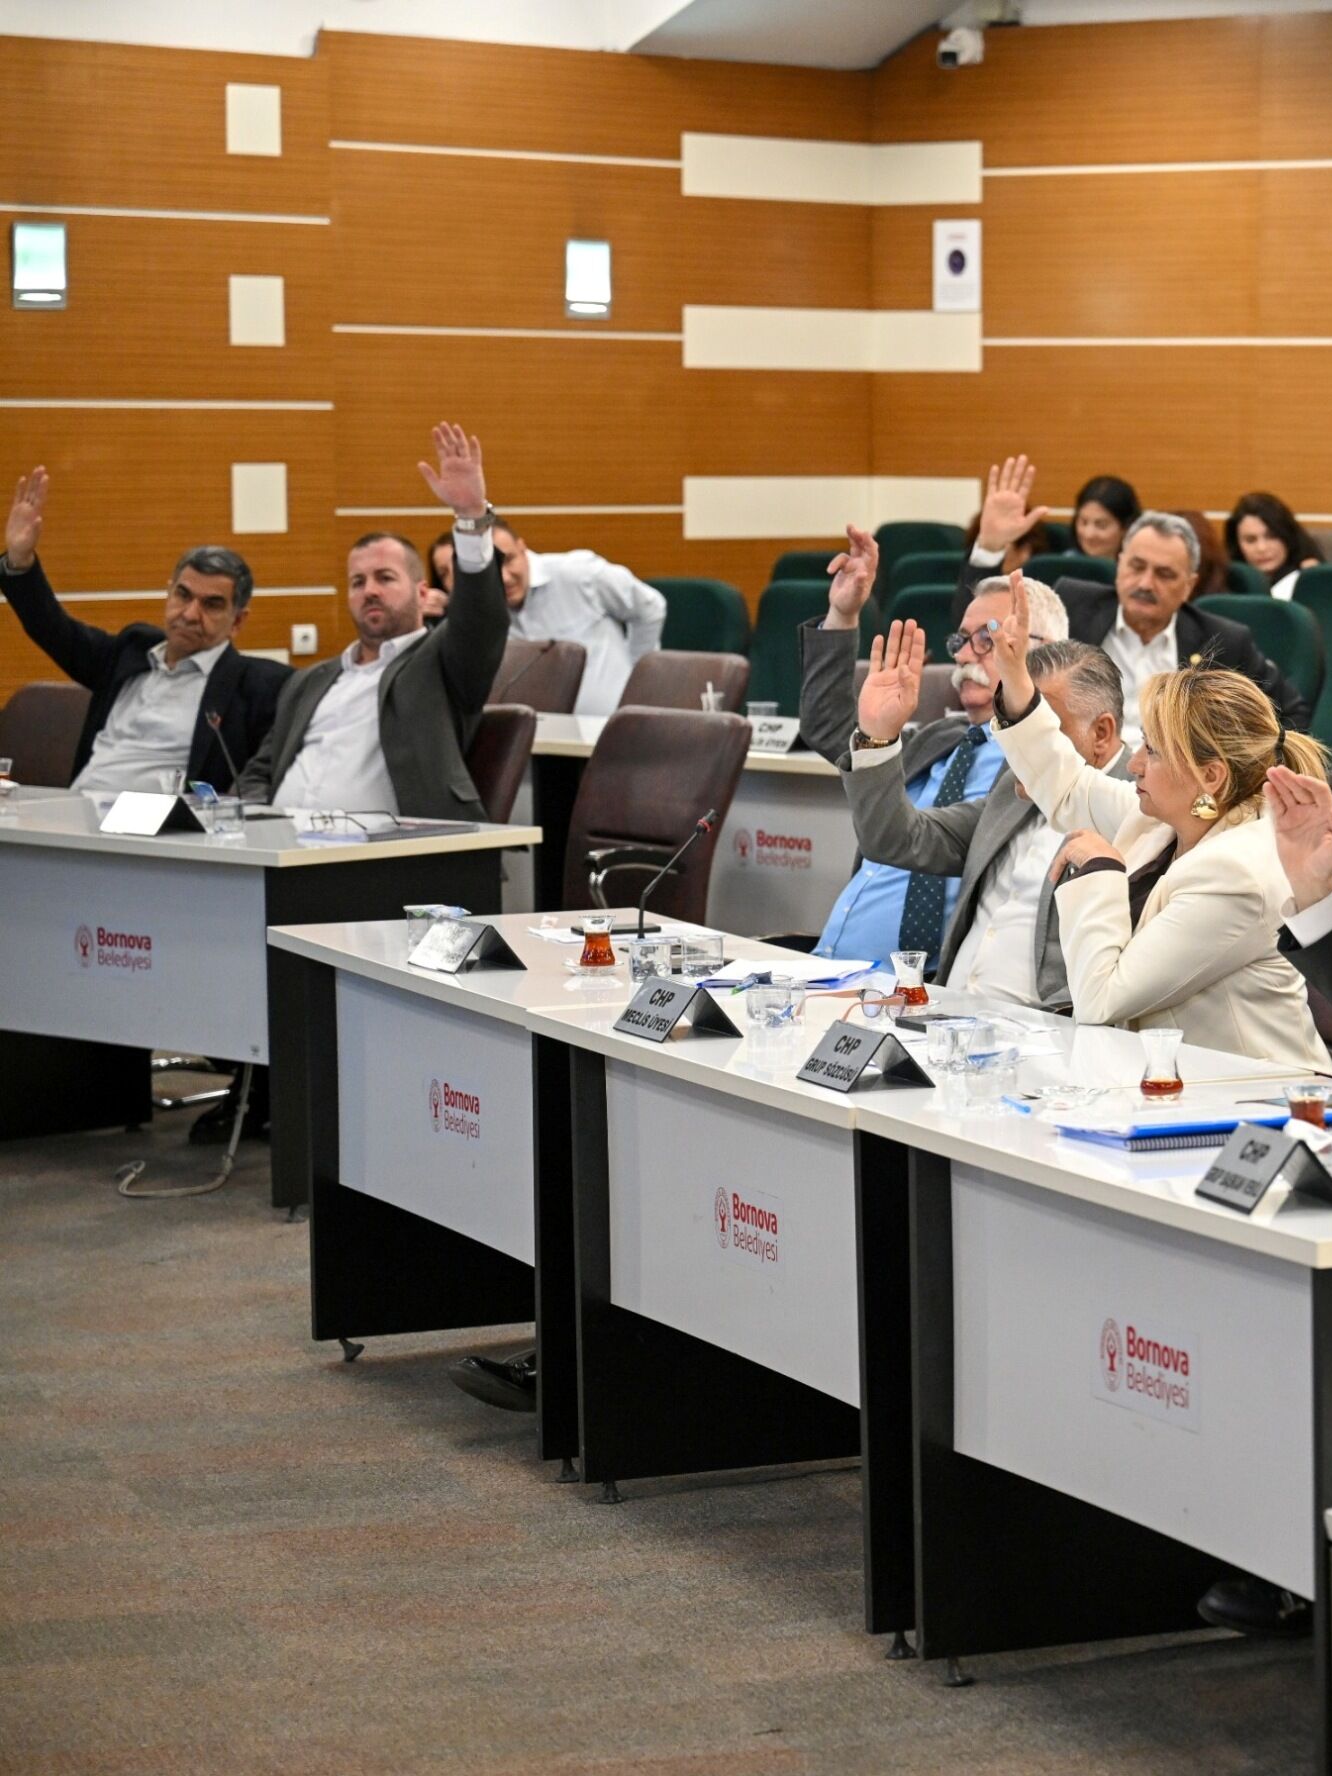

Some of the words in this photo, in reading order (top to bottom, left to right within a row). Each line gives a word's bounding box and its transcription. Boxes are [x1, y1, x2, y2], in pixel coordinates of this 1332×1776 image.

[756, 829, 811, 852] Bornova
[97, 927, 152, 951] Bornova
[97, 948, 152, 972] Belediyesi
[649, 988, 675, 1008] CHP
[834, 1034, 862, 1055] CHP
[805, 1058, 827, 1074] GRUP
[444, 1082, 480, 1115] Bornova
[444, 1110, 480, 1141] Belediyesi
[733, 1192, 777, 1236] Bornova
[733, 1224, 778, 1263] Belediyesi
[1126, 1325, 1189, 1377] Bornova
[1127, 1362, 1189, 1410] Belediyesi
